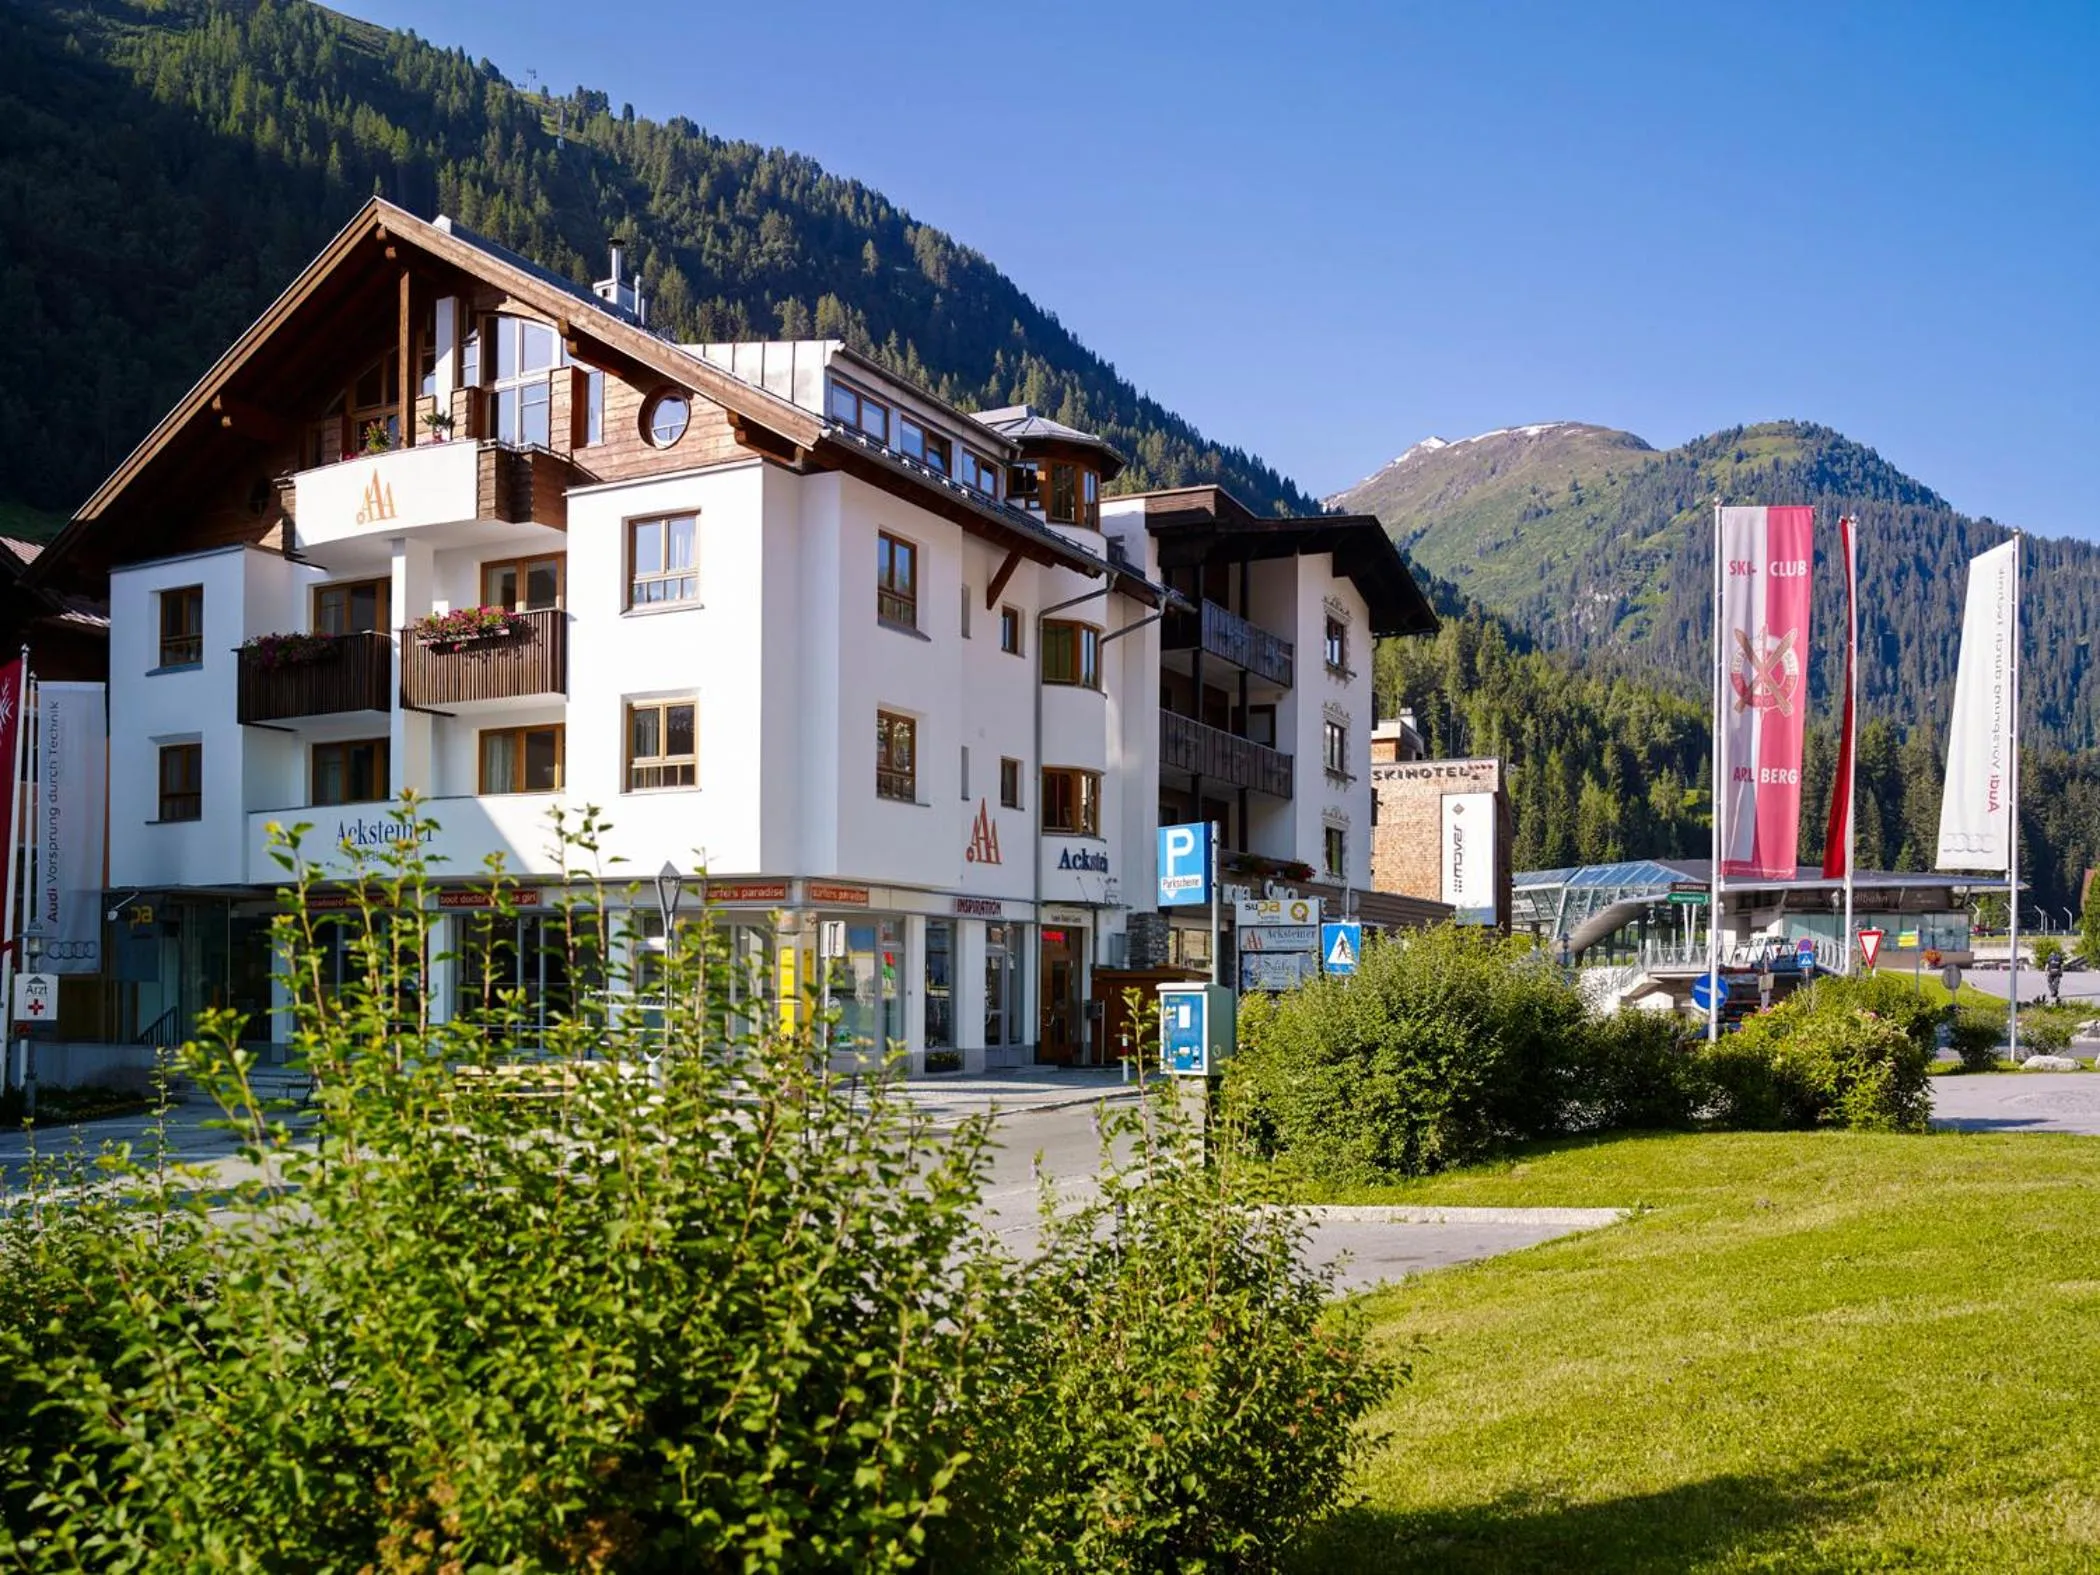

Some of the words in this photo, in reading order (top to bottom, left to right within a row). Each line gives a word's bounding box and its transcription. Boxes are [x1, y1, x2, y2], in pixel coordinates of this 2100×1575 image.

[1769, 559, 1808, 577] CLUB
[49, 701, 60, 755] Technik
[49, 761, 59, 801] durch
[1733, 766, 1755, 783] ARL
[1760, 767, 1799, 785] BERG
[47, 806, 61, 885] Vorsprung
[1166, 828, 1195, 878] P
[741, 886, 785, 899] paradise
[46, 887, 59, 924] Audi
[956, 898, 1002, 917] INSPIRATION
[1244, 901, 1281, 919] supa
[25, 983, 49, 995] Arzt
